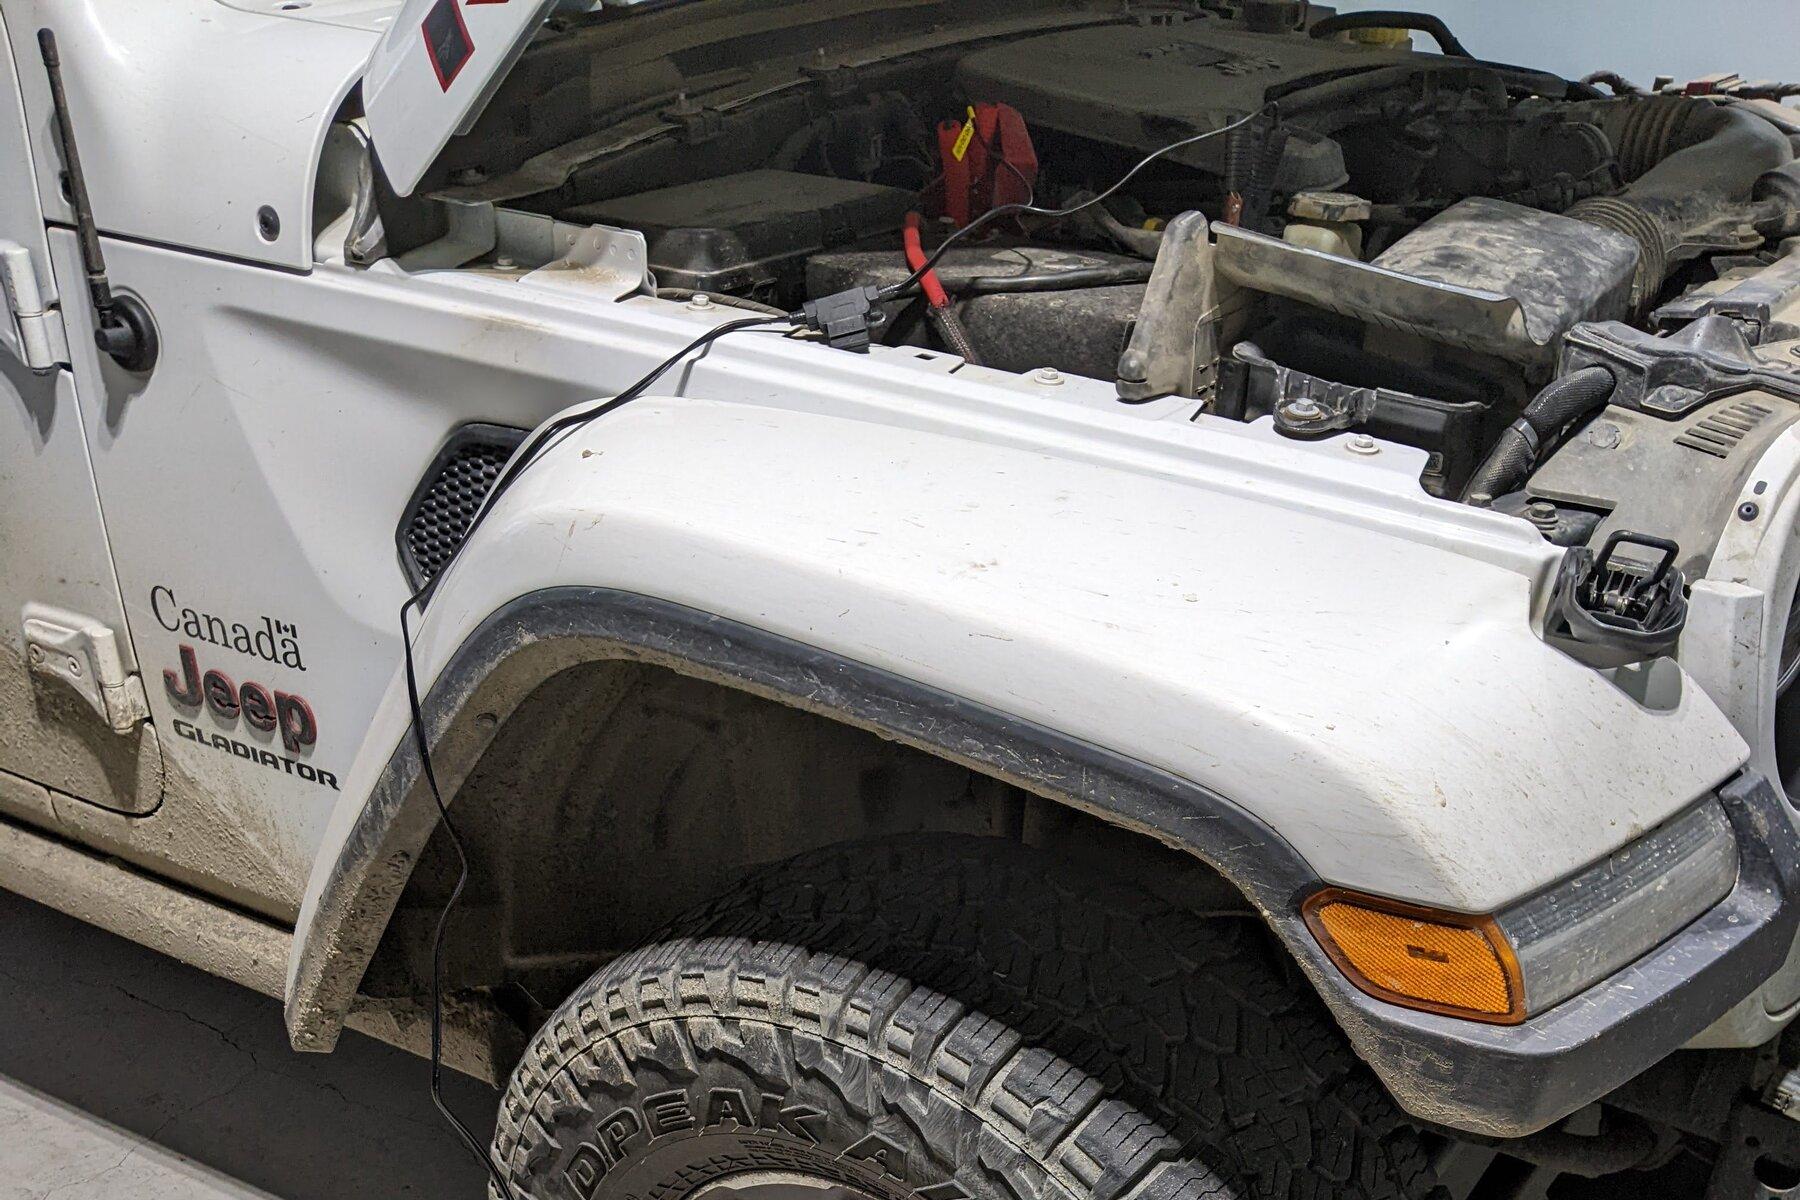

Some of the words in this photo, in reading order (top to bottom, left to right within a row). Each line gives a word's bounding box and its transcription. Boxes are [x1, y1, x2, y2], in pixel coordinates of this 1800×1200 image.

[150, 585, 307, 671] Canada
[162, 643, 318, 755] Jeep
[172, 718, 342, 792] GLADIATOR
